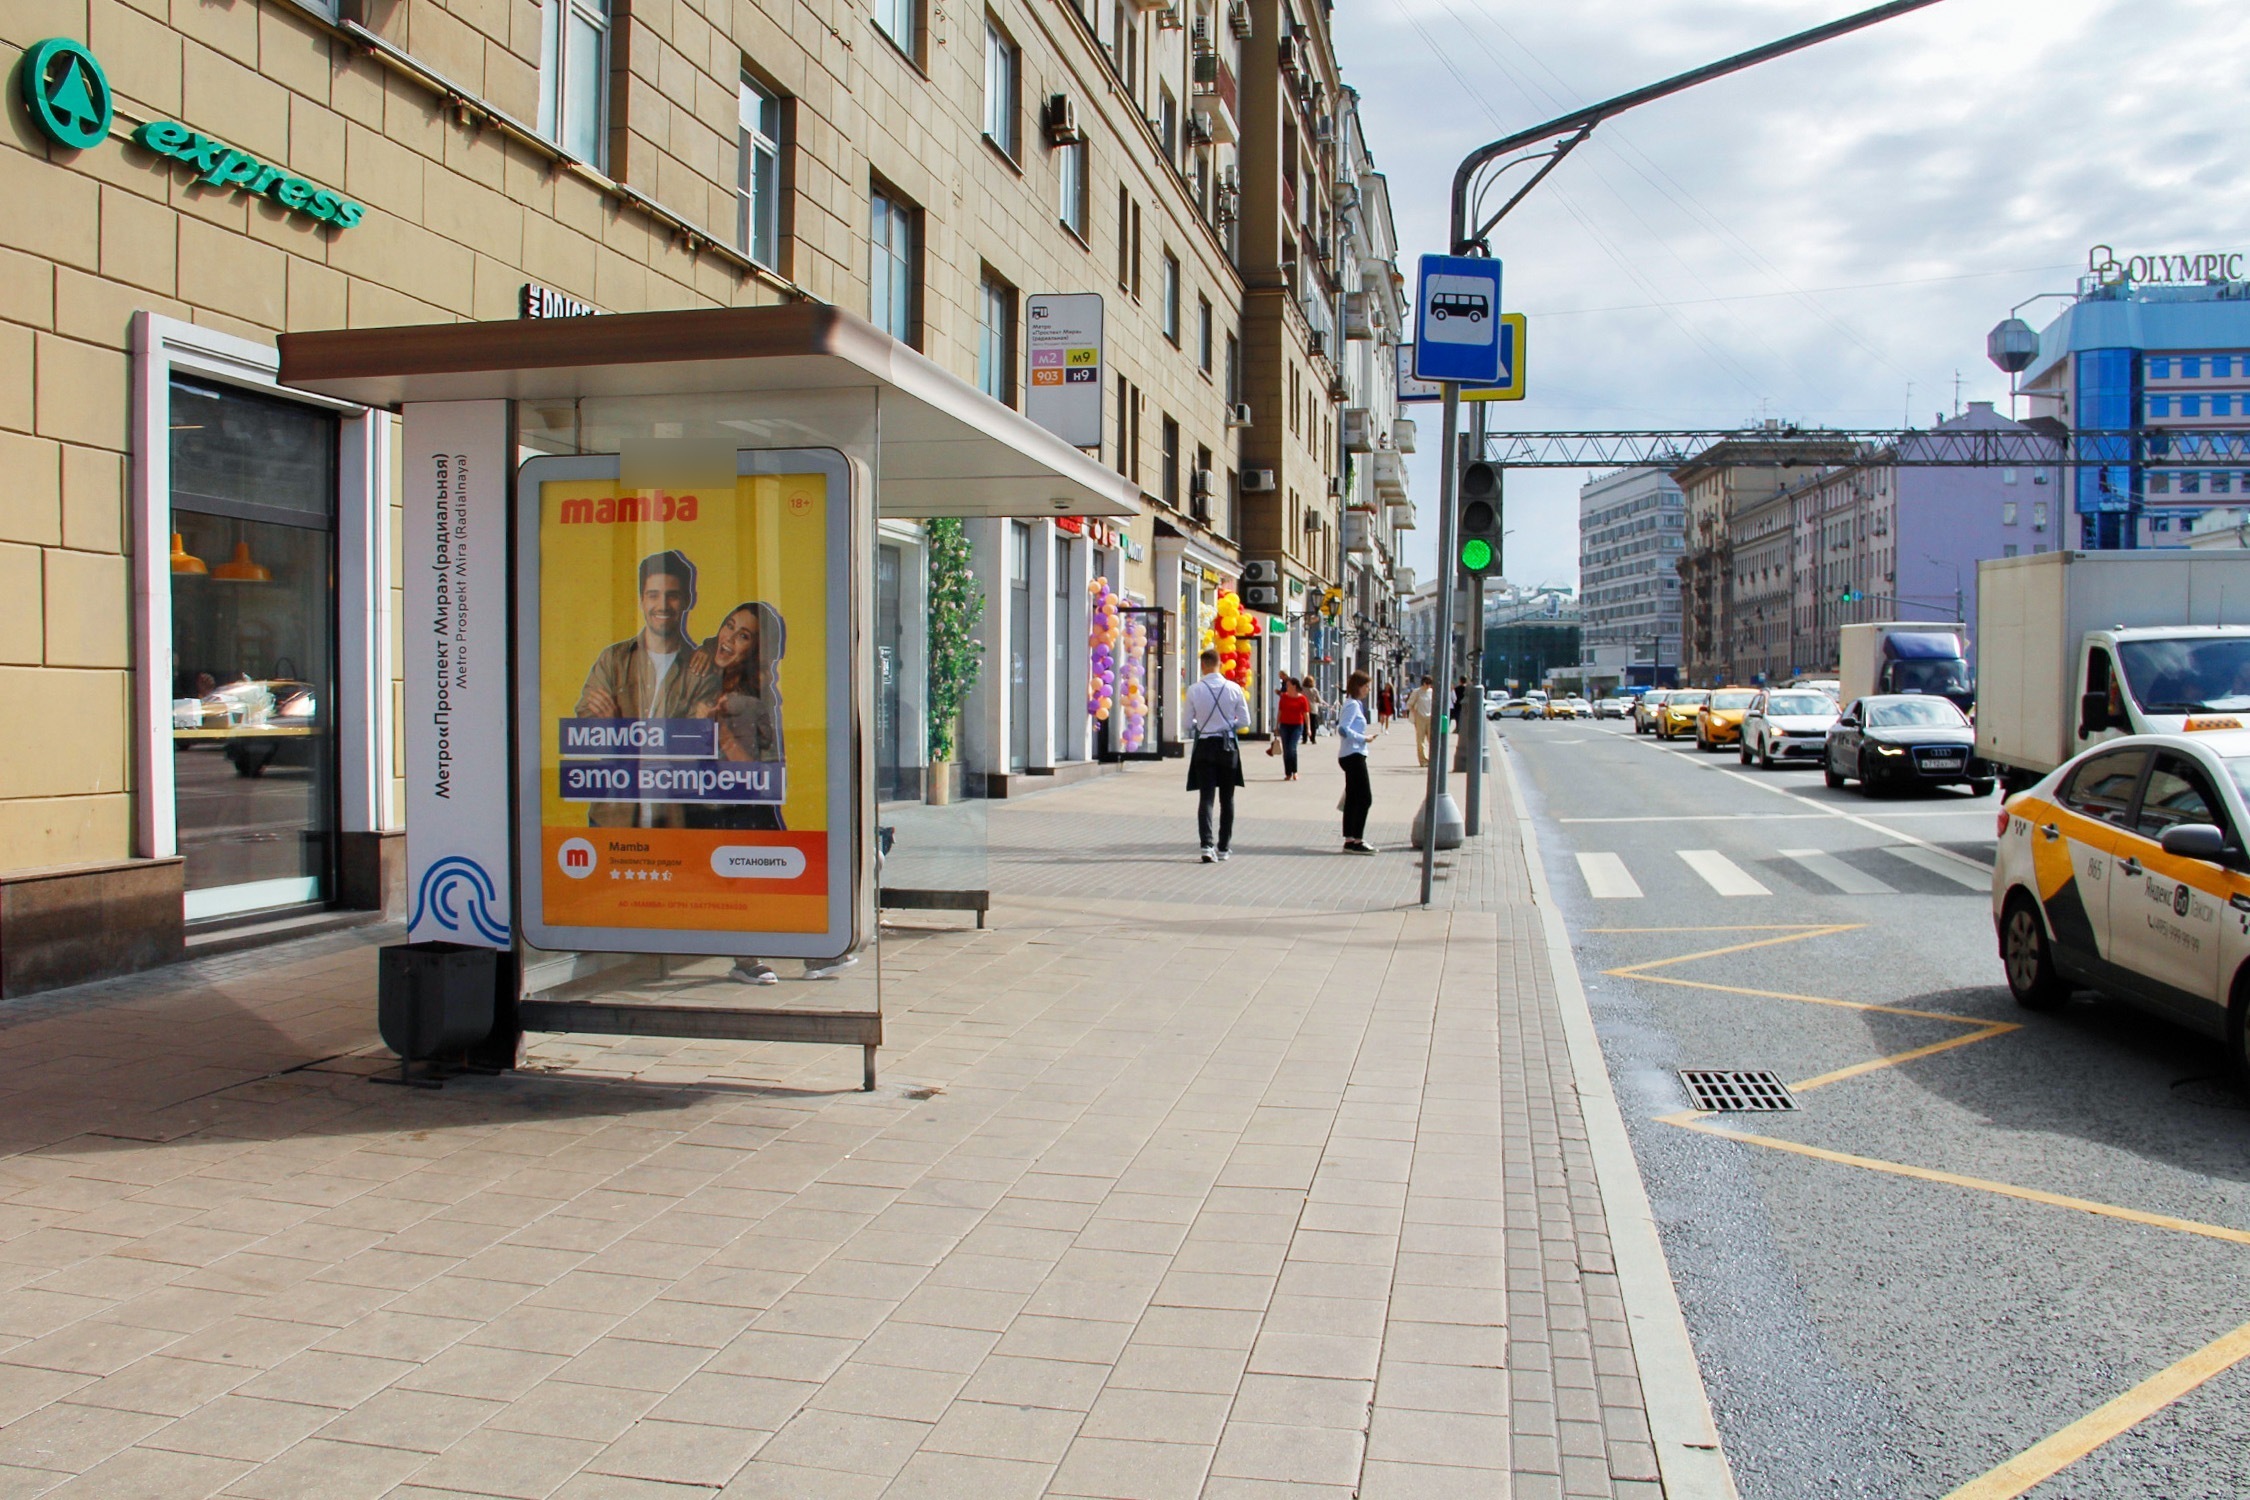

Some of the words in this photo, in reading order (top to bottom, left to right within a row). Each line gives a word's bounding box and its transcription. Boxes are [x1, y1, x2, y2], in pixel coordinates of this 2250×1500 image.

[132, 120, 367, 229] express
[2129, 254, 2243, 283] OLYMPIC
[1036, 371, 1059, 381] 903
[431, 453, 452, 571] (радиальная)
[454, 454, 469, 539] (Radialnaya)
[560, 489, 698, 525] mamba
[790, 498, 810, 509] 18+
[455, 543, 467, 577] Mira
[455, 581, 469, 641] Prospekt
[456, 646, 467, 689] Metro
[567, 721, 665, 747] мамба
[568, 769, 630, 789] это
[638, 769, 771, 796] встречи
[609, 841, 650, 852] Mamba
[729, 857, 788, 868] УСТАНОВИТЬ
[2087, 857, 2103, 881] 865
[2145, 876, 2173, 907] Яндекс
[2190, 893, 2213, 922] Такси
